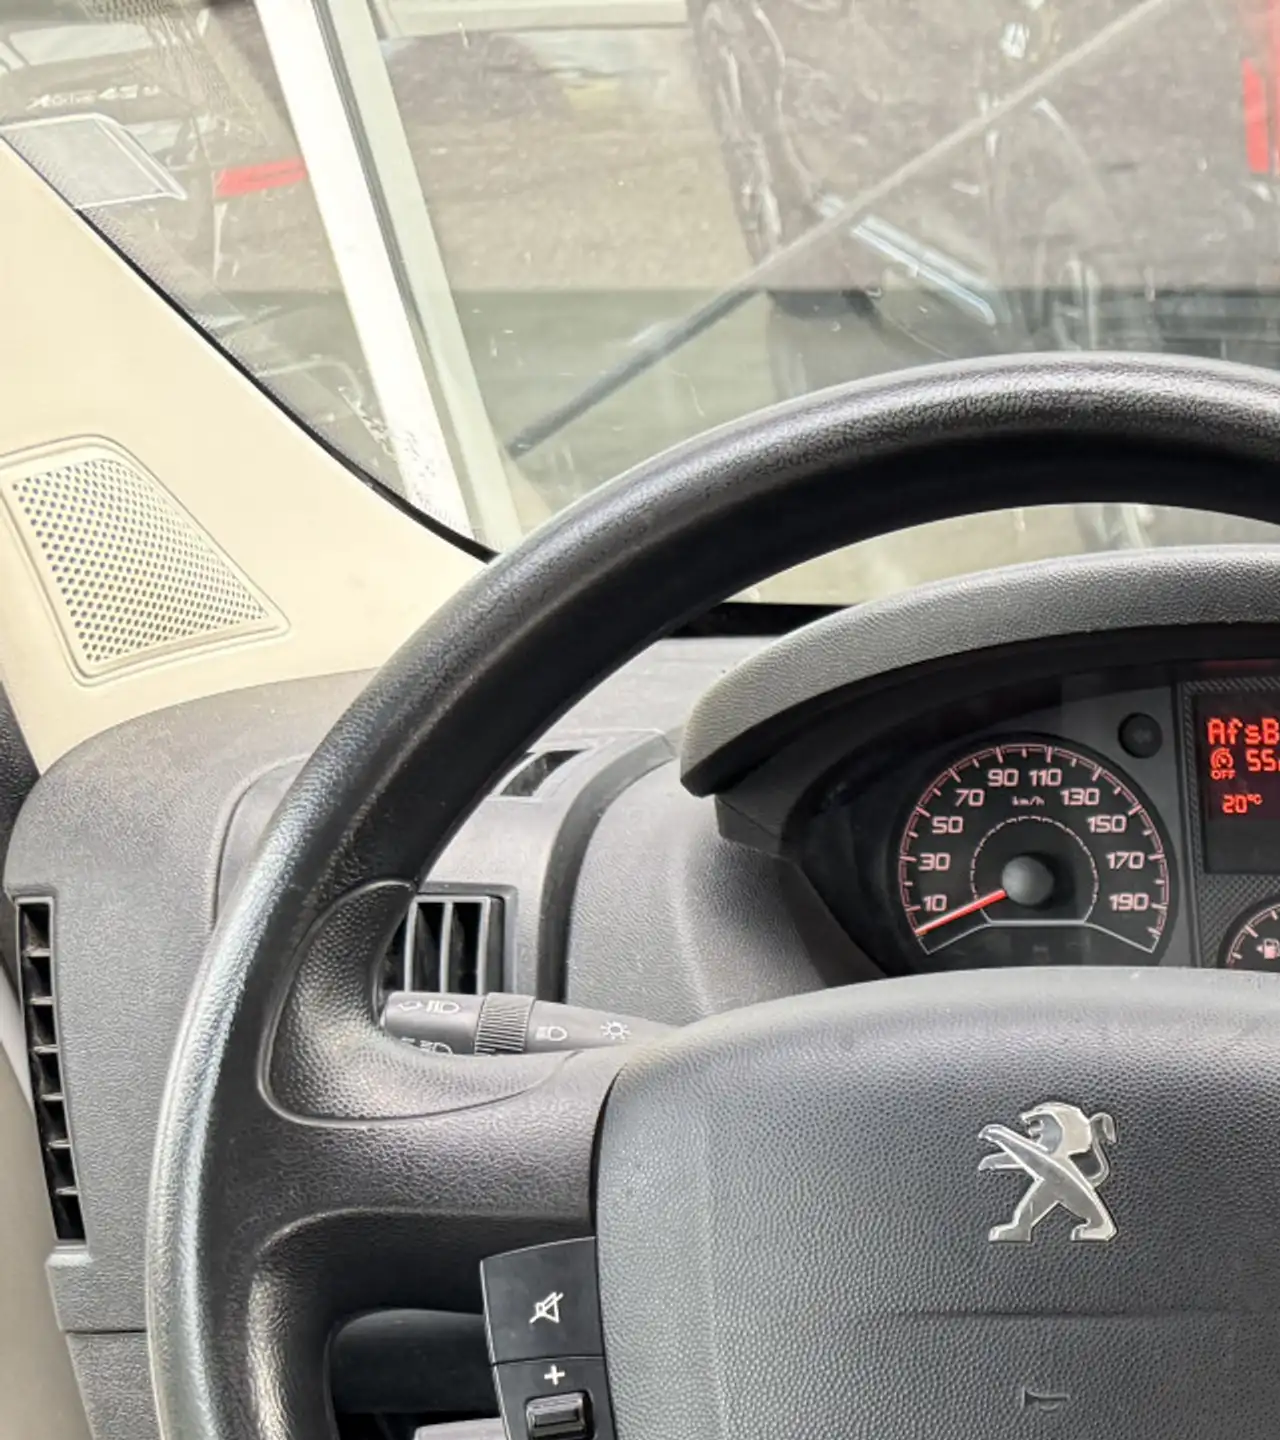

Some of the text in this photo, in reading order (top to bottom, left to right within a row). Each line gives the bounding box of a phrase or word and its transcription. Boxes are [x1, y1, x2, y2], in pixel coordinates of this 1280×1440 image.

[1207, 717, 1280, 745] AfsB
[987, 768, 1019, 787] 90
[1029, 768, 1063, 787] 110
[1210, 769, 1236, 780] OFF
[954, 788, 985, 807] 70
[1011, 795, 1045, 807] km/h
[1060, 788, 1100, 806] 130
[931, 816, 963, 834] 50
[1087, 815, 1127, 833] 150
[919, 853, 950, 871] 30
[1105, 852, 1145, 870] 170
[923, 894, 948, 913] 10
[1109, 893, 1149, 912] 190
